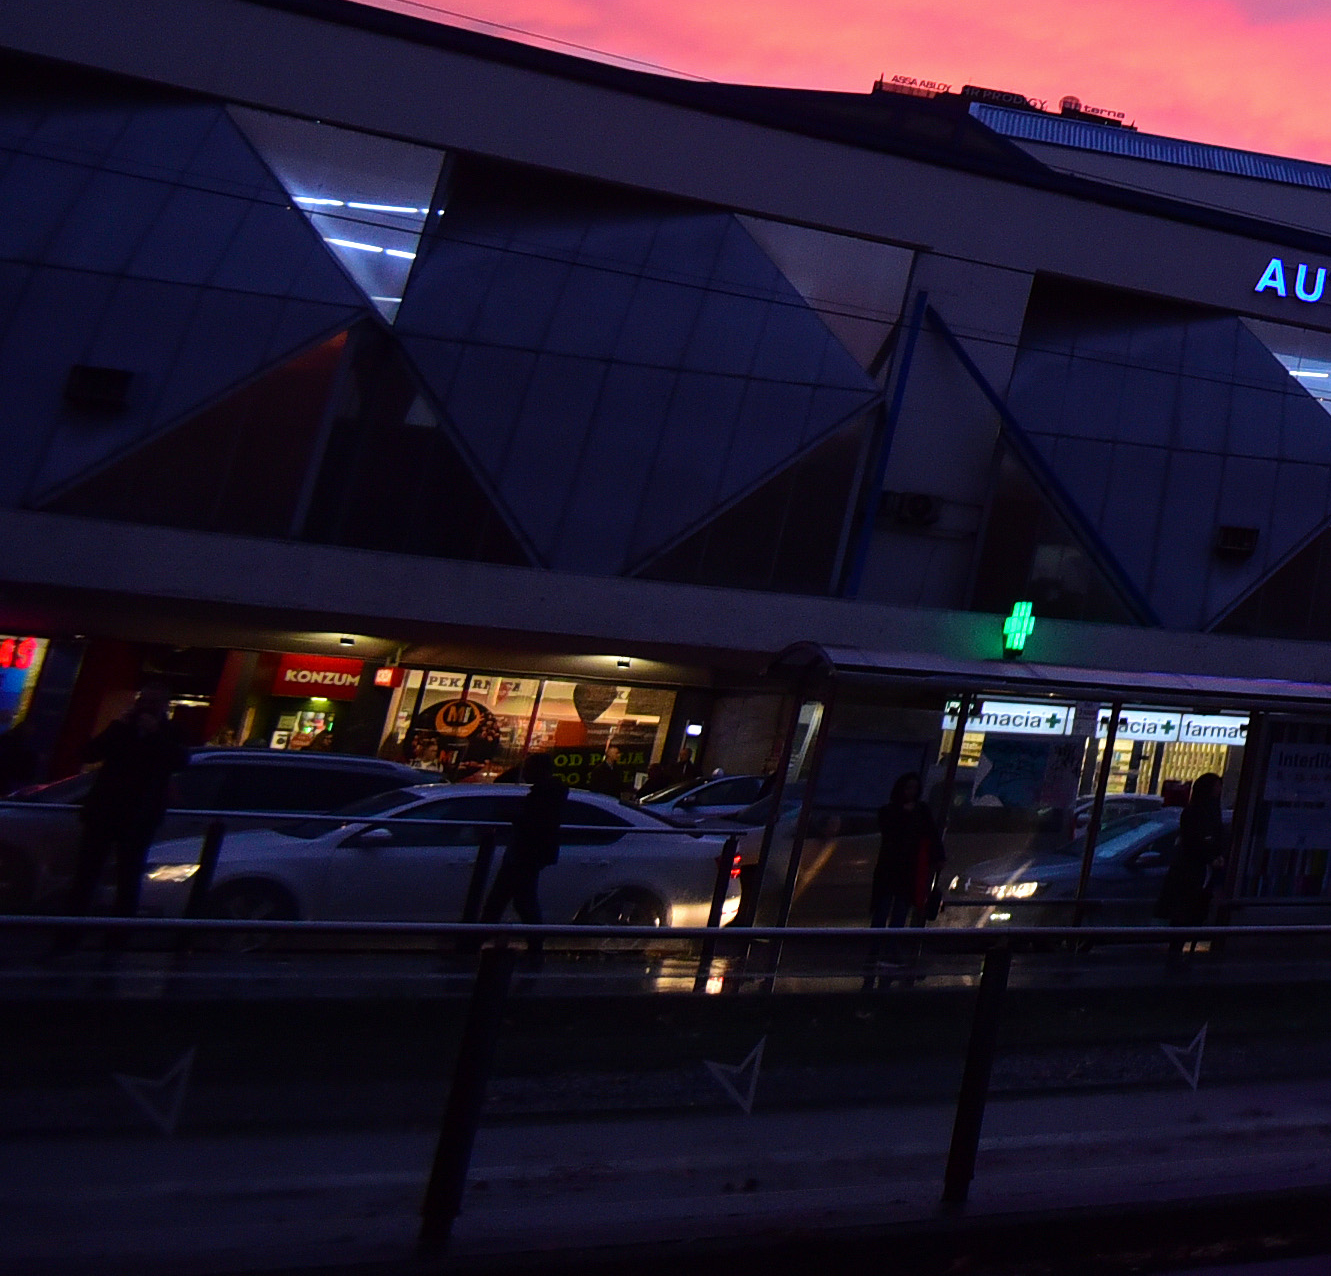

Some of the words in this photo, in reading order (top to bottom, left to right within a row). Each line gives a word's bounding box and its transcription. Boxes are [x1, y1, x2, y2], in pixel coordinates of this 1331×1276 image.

[891, 75, 918, 86] ASSA
[982, 90, 1048, 112] PRODIGY
[284, 669, 361, 686] KONZUM
[589, 751, 645, 766] PLJA
